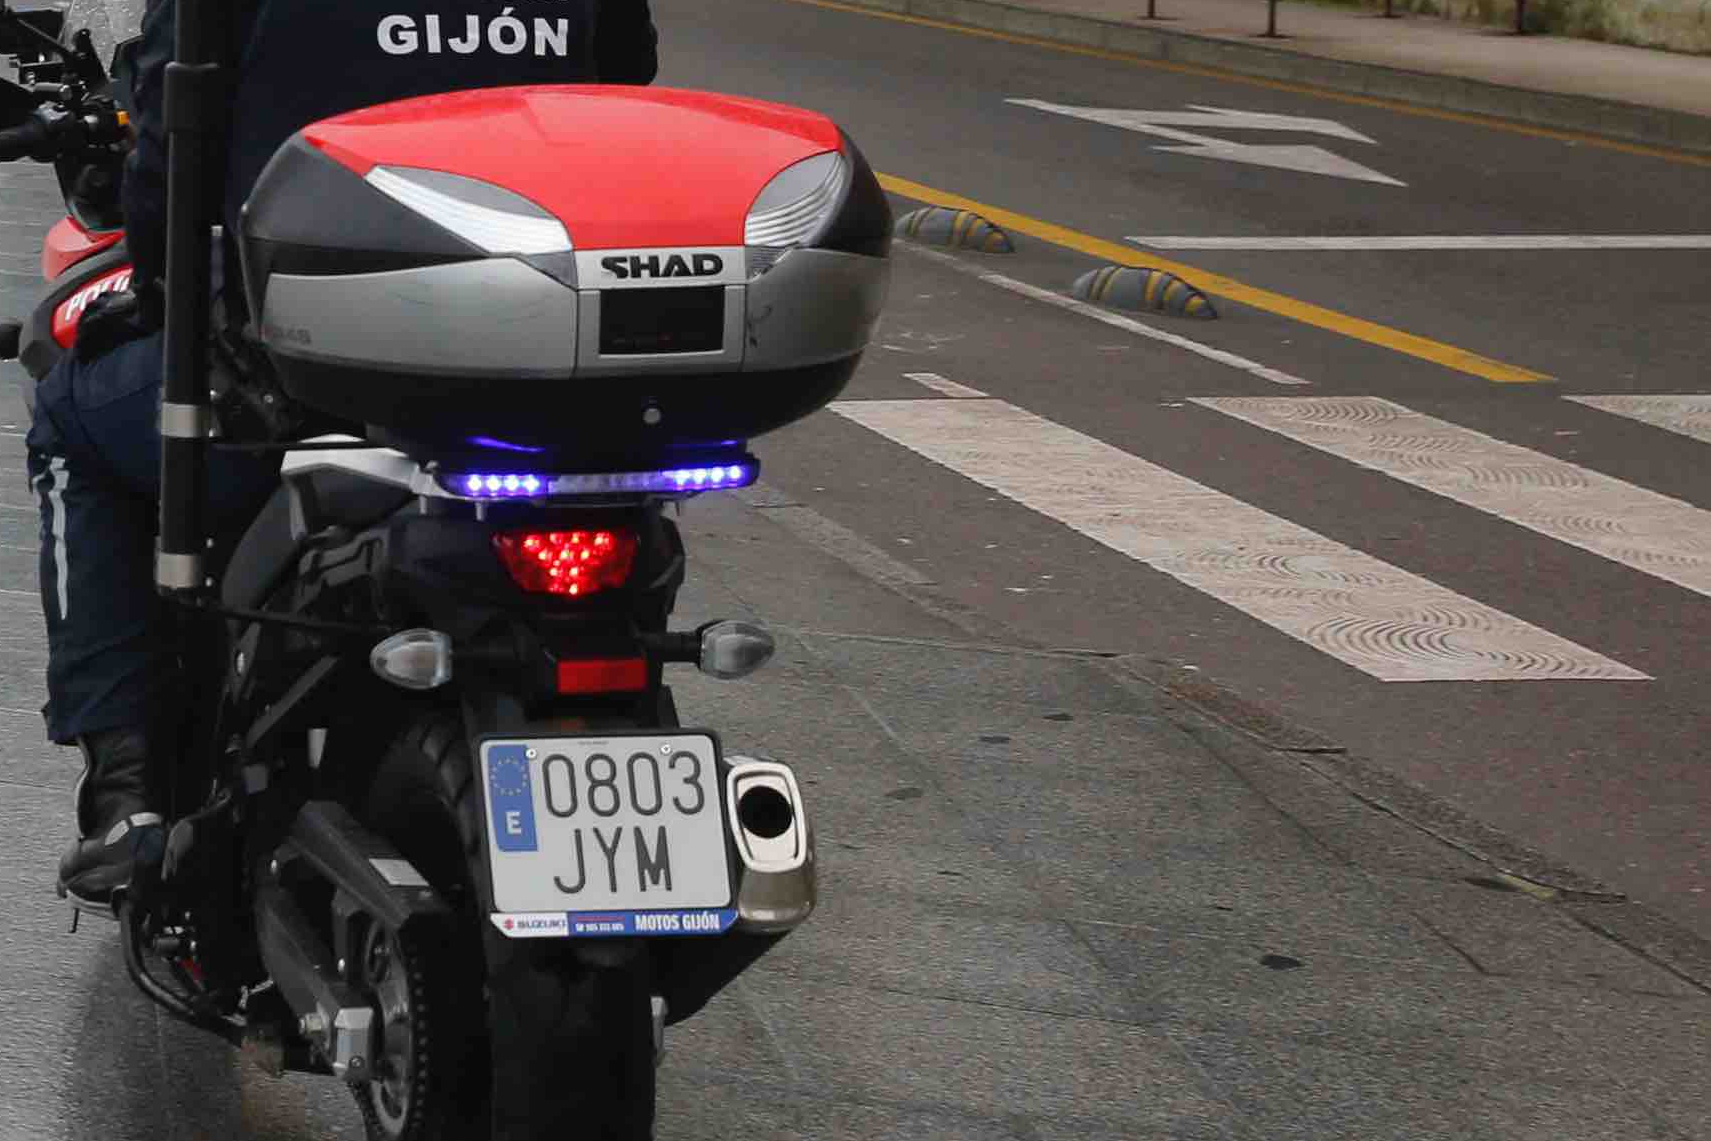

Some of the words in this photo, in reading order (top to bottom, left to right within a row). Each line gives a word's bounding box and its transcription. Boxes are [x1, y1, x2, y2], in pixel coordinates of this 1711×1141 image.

[377, 7, 569, 57] GIJÓN
[601, 254, 723, 279] SHAD
[542, 751, 705, 818] 0803
[506, 811, 522, 835] E
[554, 826, 673, 894] JYM
[635, 914, 680, 931] MOTOS
[682, 911, 720, 931] GIJÓN
